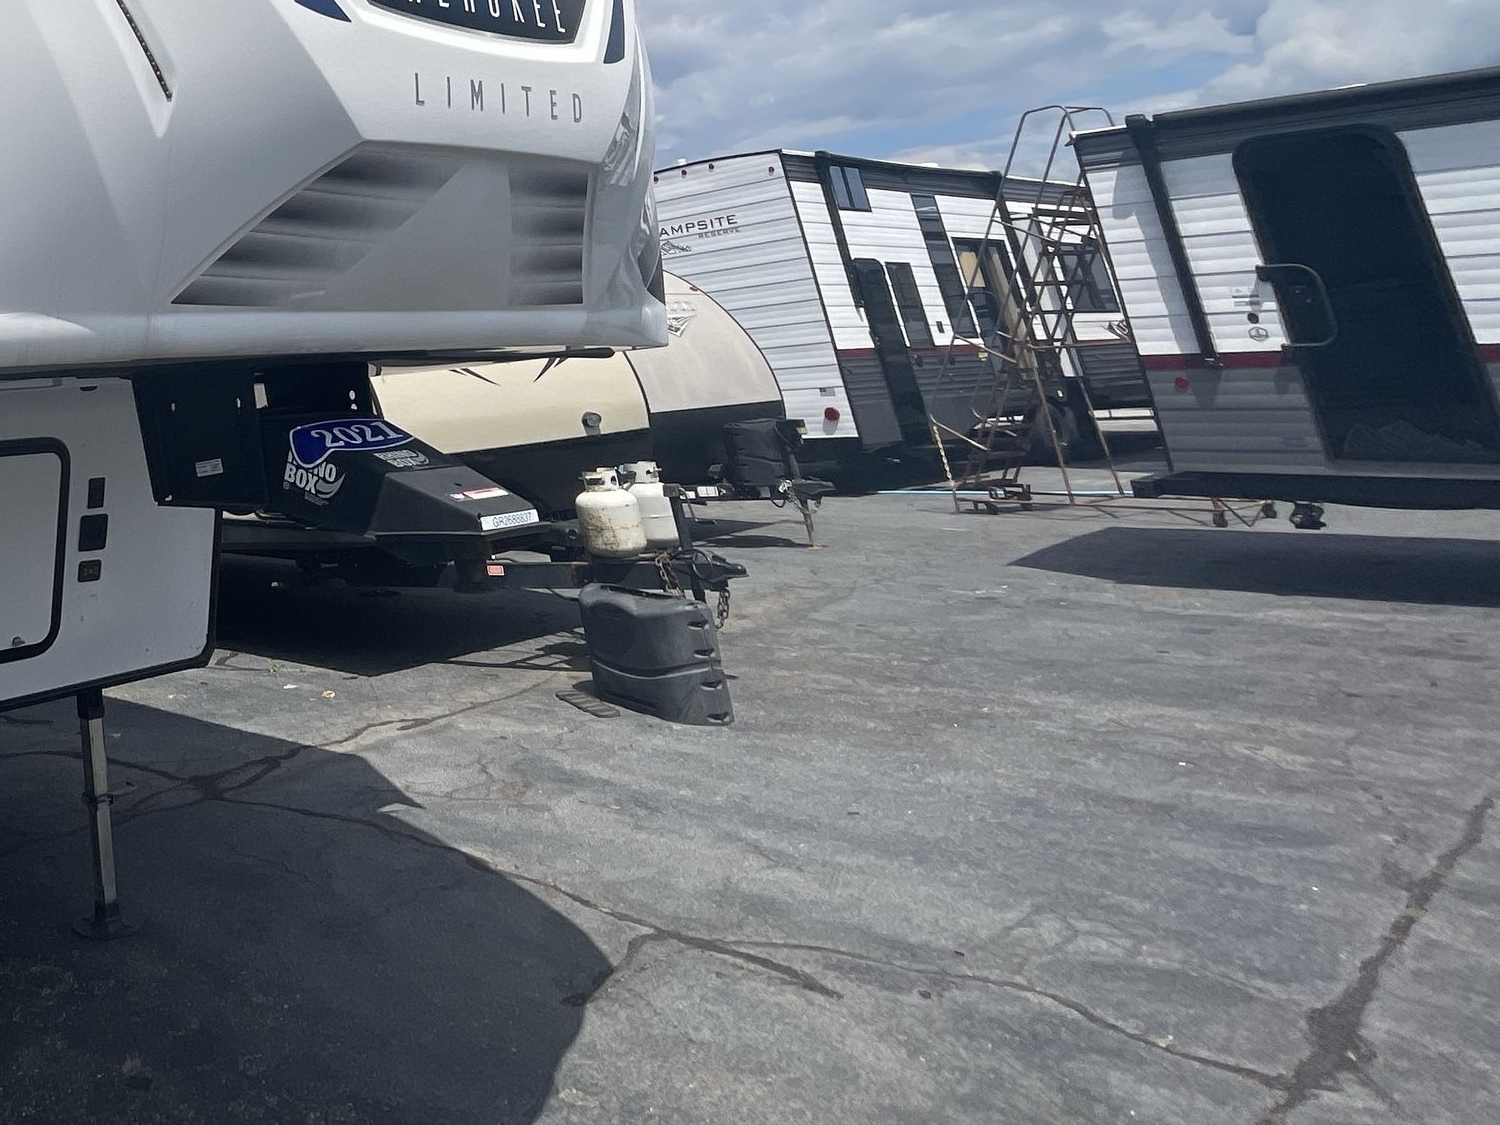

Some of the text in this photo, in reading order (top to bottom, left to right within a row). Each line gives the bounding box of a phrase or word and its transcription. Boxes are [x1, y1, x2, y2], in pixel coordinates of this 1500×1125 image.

[414, 72, 583, 123] LIMITED
[697, 226, 741, 239] RESERVE
[311, 421, 404, 448] 2021
[284, 462, 319, 495] BOX
